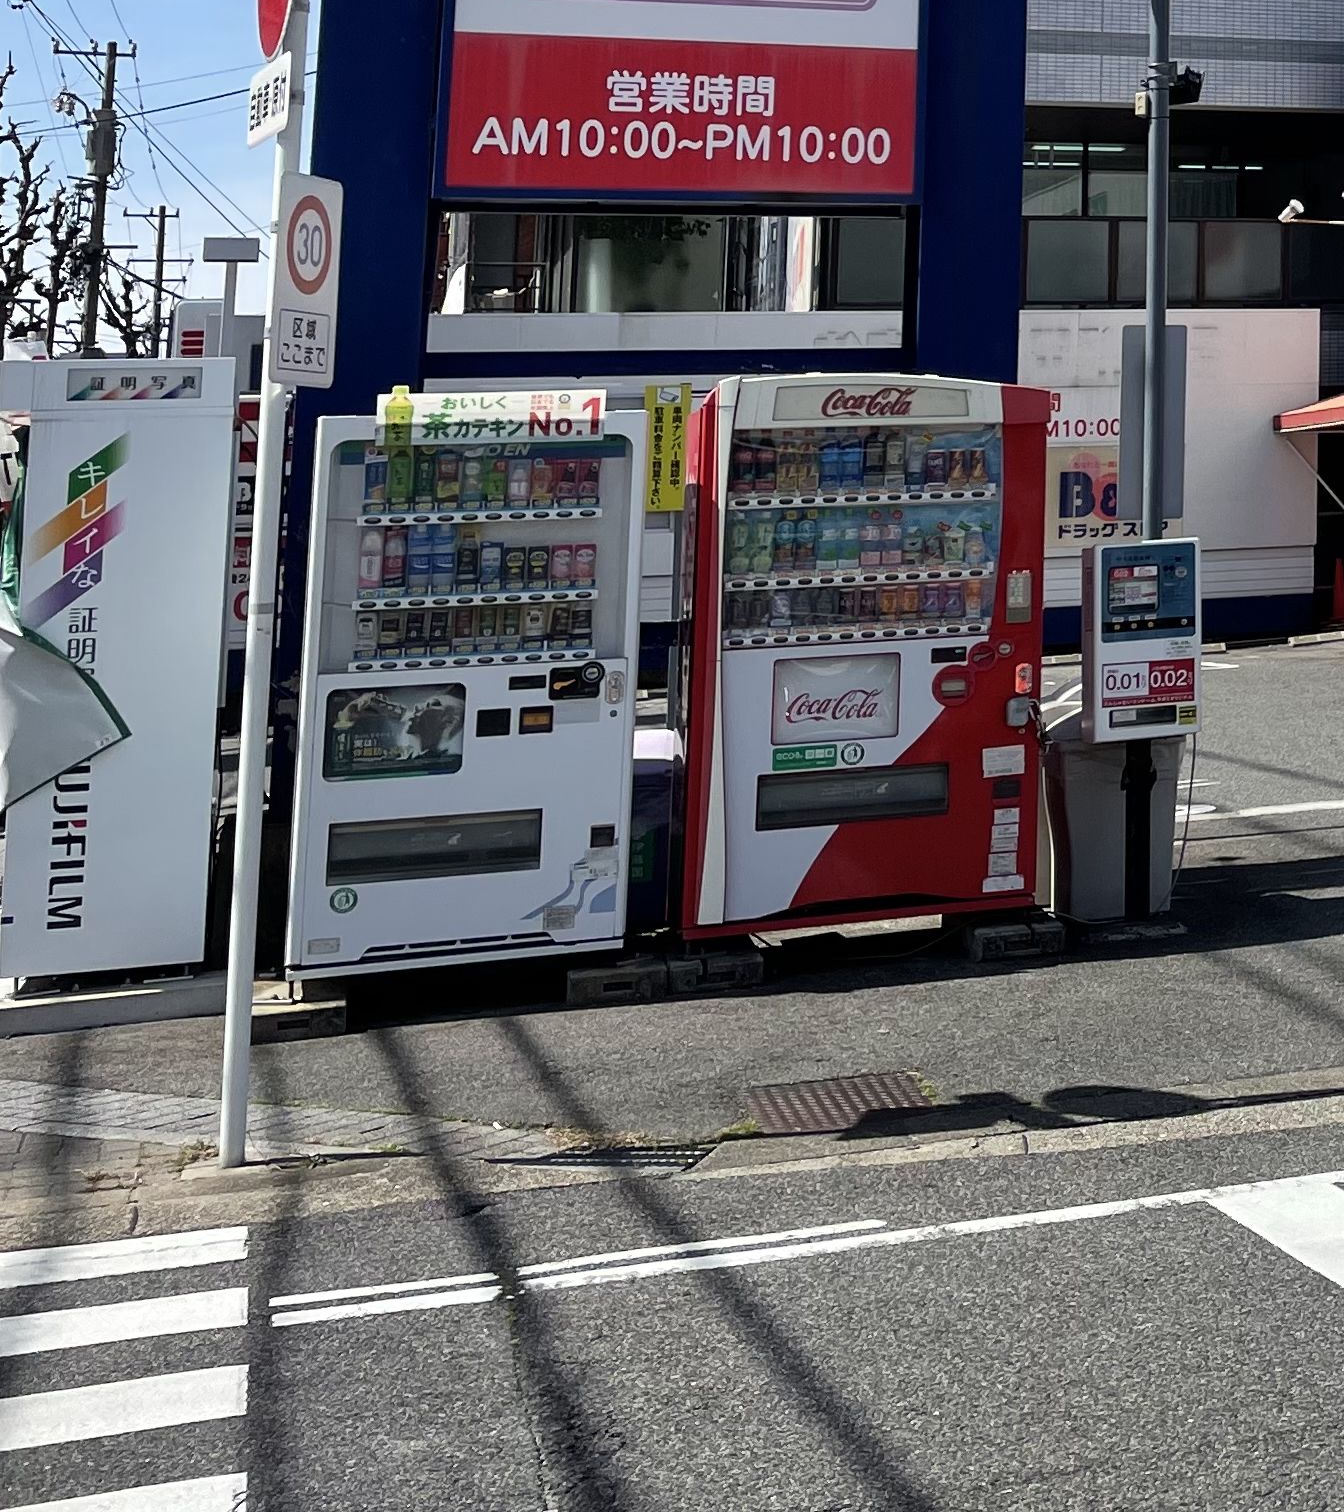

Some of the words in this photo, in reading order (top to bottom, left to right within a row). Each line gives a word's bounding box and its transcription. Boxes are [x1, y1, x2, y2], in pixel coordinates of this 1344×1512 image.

[606, 70, 775, 117] 営業時間
[297, 223, 323, 266] 30
[280, 343, 326, 367] ここまで
[90, 375, 197, 391] 証明写真
[422, 413, 523, 439] 茶カテキン
[528, 397, 601, 436] No.1
[441, 396, 507, 410] おいしく
[821, 388, 917, 417] Coca-Cola
[1106, 672, 1140, 691] 0.01
[1150, 669, 1187, 688] 0.02
[786, 689, 883, 723] Coca-Cola
[47, 760, 91, 929] UJIFILM
